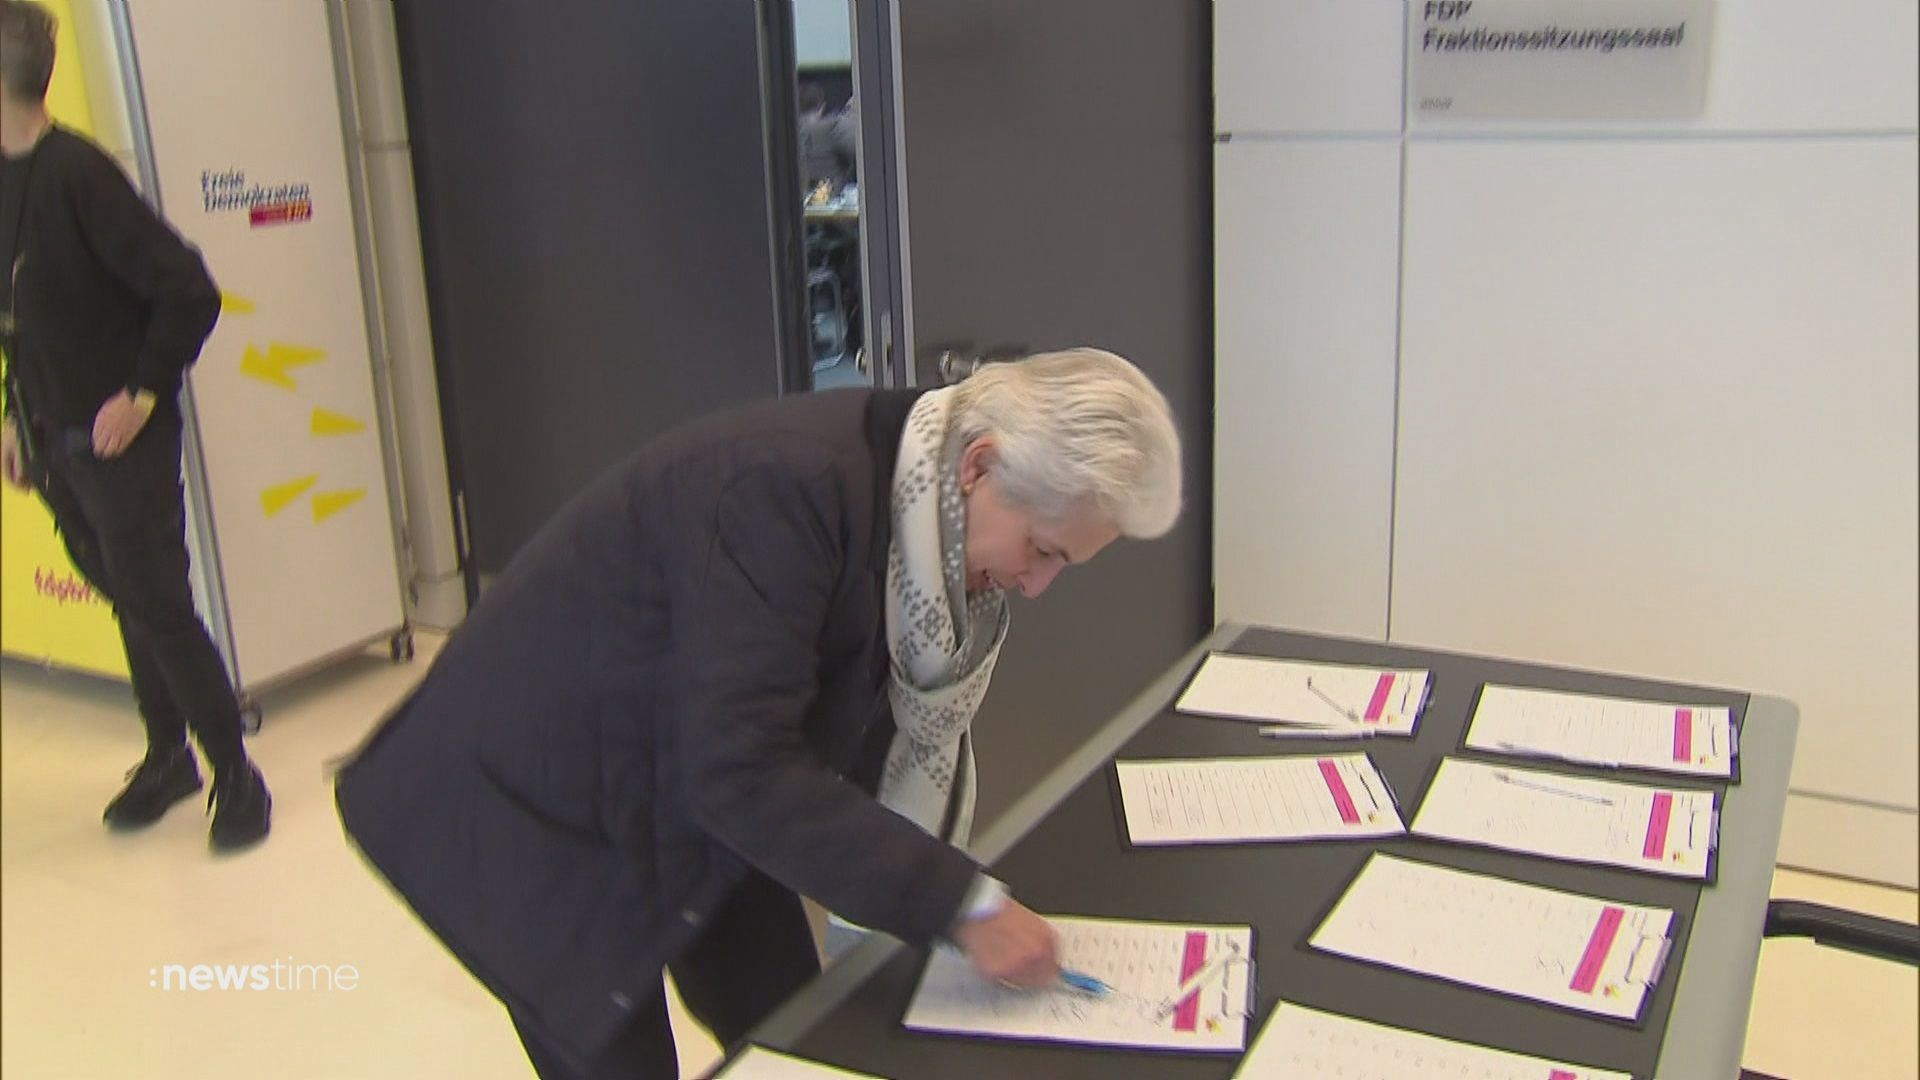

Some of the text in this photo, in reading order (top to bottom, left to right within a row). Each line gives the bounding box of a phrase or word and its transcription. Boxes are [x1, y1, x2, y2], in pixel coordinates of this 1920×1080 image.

[1424, 0, 1471, 21] FDP
[1423, 21, 1686, 52] Fraktionssitzungssaal
[201, 169, 245, 191] Freie
[203, 184, 310, 212] Demokraten
